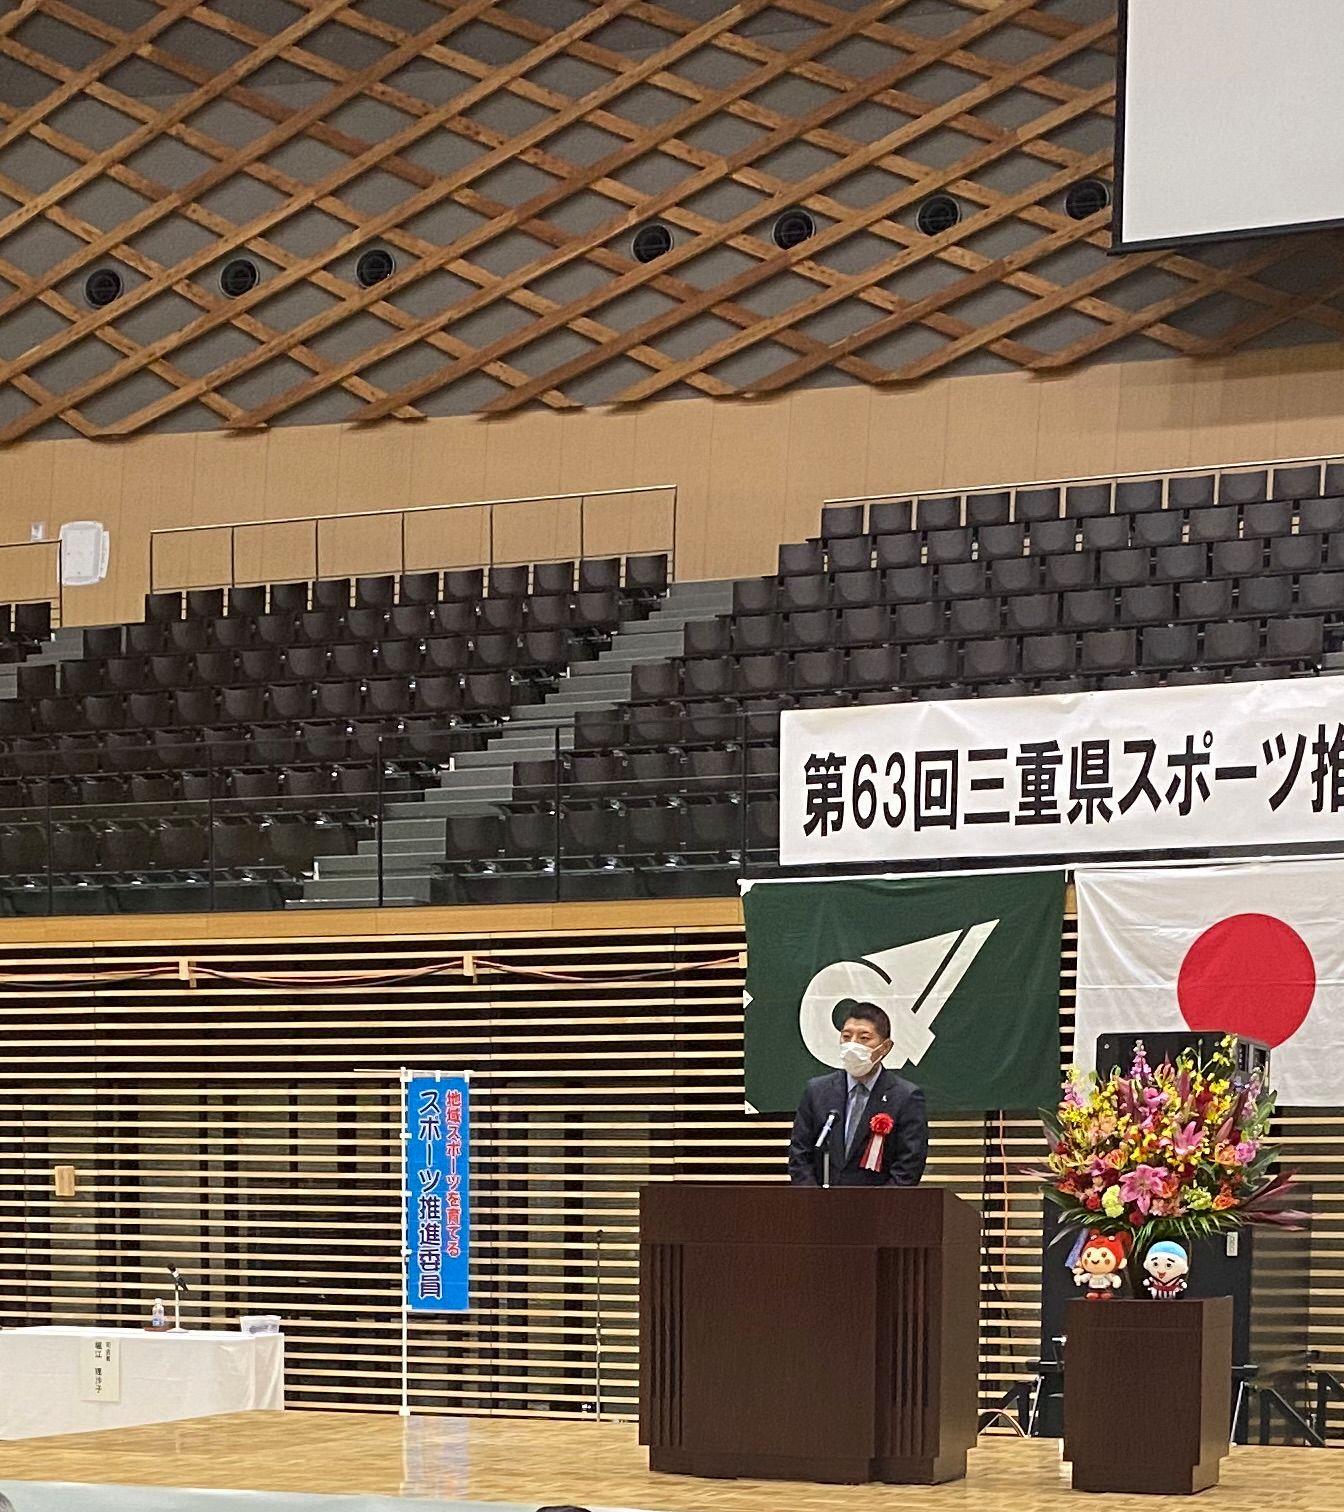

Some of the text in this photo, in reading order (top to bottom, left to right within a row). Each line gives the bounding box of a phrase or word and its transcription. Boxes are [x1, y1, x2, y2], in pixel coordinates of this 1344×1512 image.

[418, 1088, 441, 1300] スポーツ推進委員
[444, 1091, 462, 1257] 地域スポーツを育てる
